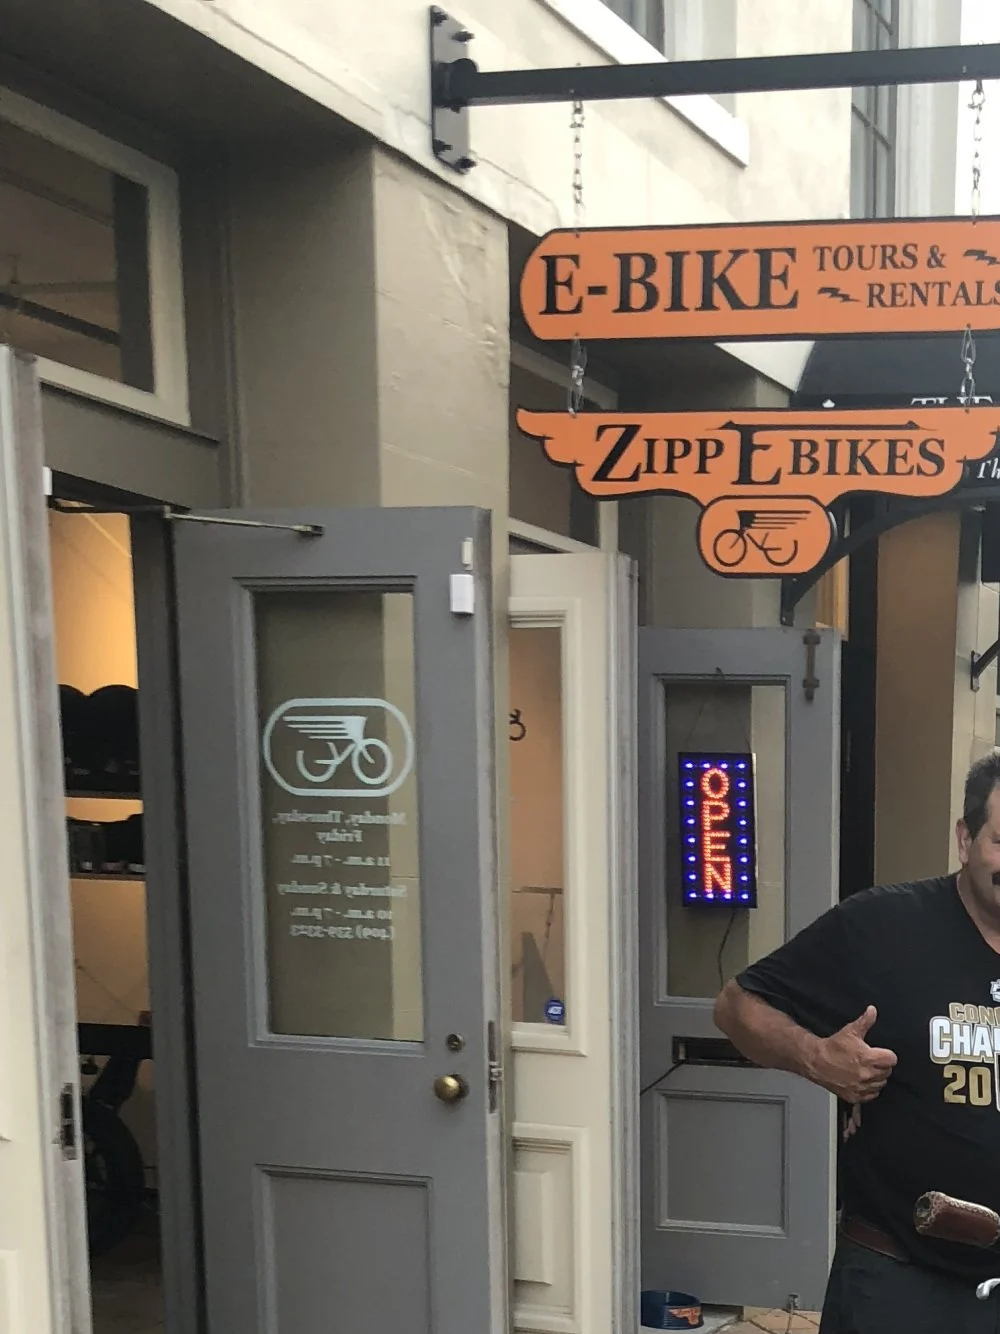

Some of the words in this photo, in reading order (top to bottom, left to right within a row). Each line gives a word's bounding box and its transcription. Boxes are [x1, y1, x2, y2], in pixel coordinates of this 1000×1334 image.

[813, 244, 918, 271] TOURS
[926, 245, 946, 270] &
[539, 246, 799, 316] E-BIKE
[975, 460, 1000, 480] The
[700, 767, 733, 893] OPEN
[943, 1065, 992, 1107] 20
